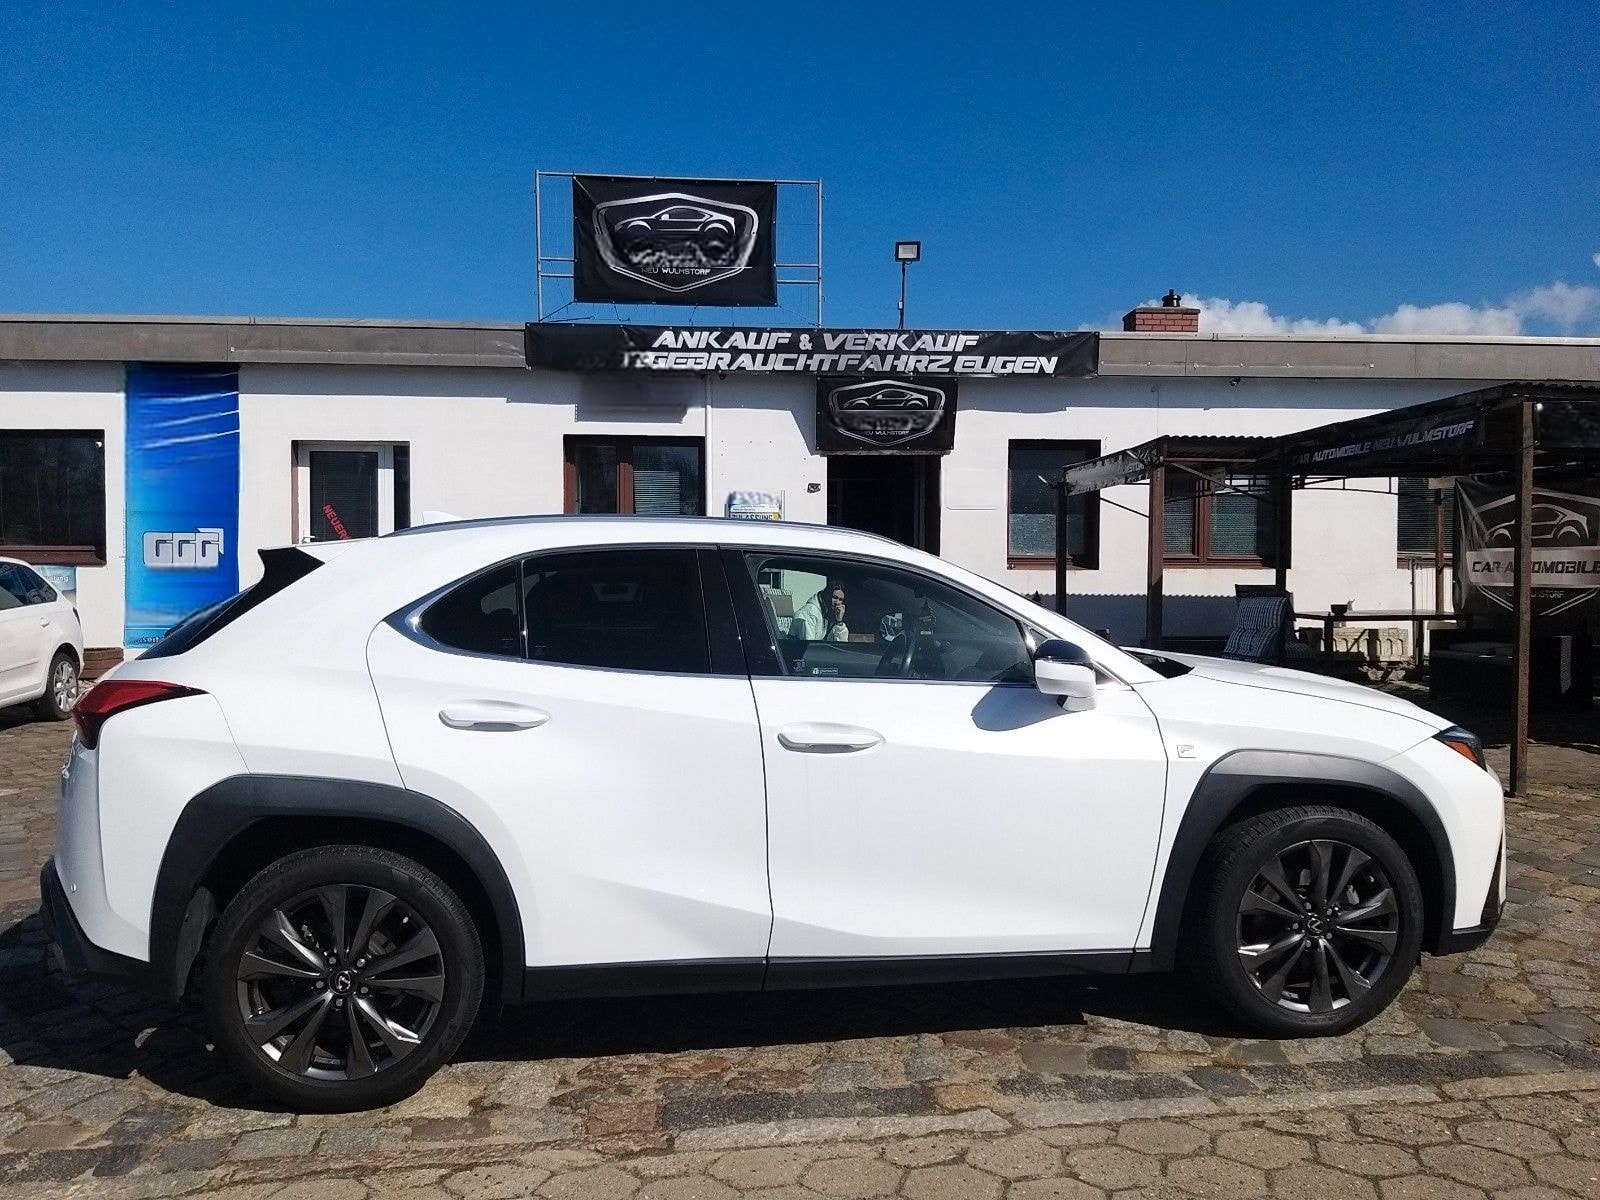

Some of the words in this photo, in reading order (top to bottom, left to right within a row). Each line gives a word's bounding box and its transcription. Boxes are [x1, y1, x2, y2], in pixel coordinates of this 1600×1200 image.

[661, 267, 711, 275] WULMSTORF
[652, 330, 792, 350] ANKAUF
[799, 333, 813, 350] &
[823, 333, 980, 351] VERKAUF
[1312, 441, 1372, 463] AUTOMOBILE
[1373, 437, 1395, 452] NEU
[1398, 420, 1475, 447] WULMSTORF
[1472, 561, 1502, 573] CAR
